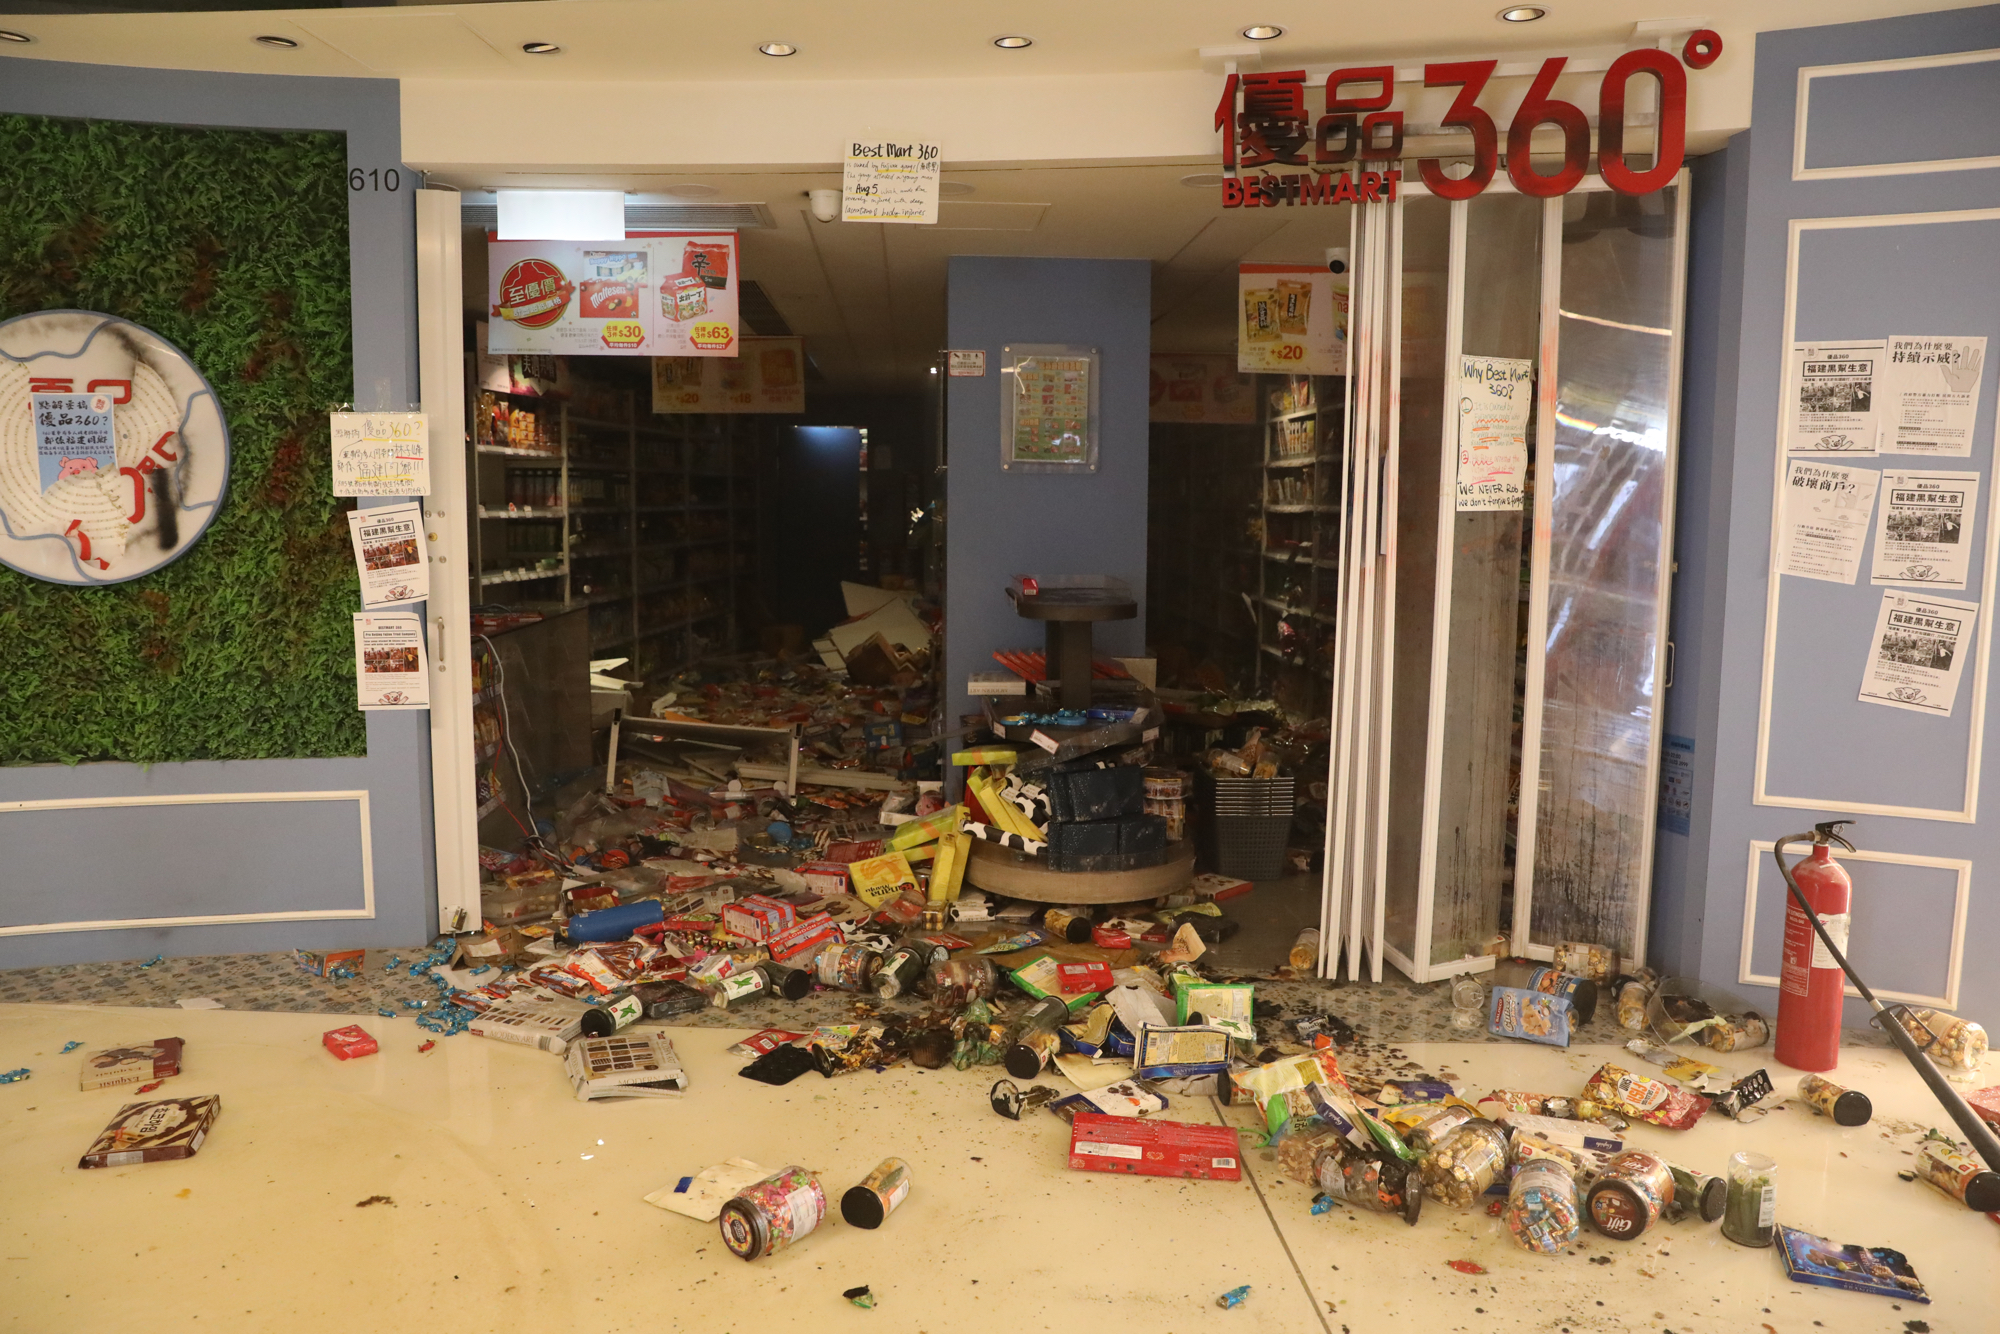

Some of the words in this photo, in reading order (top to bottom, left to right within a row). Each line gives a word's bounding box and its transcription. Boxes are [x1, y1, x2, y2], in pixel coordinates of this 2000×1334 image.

[853, 143, 884, 157] Best
[886, 142, 913, 158] Mart
[917, 143, 938, 160] 360
[871, 162, 879, 172] by
[349, 168, 400, 192] 610
[855, 184, 870, 196] Aug
[872, 183, 879, 195] 5
[1221, 169, 1402, 208] BESTMART
[691, 252, 711, 276] 辛
[509, 277, 556, 305] 至優價
[590, 286, 627, 309] Maltesers
[618, 325, 641, 338] $30
[707, 326, 730, 339] $63
[1894, 342, 1953, 351] 我們為什麼要
[1892, 351, 1961, 364] 持續示威?
[1464, 362, 1483, 384] Why
[1486, 363, 1507, 381] Best
[1510, 367, 1529, 383] Mart
[1807, 363, 1868, 373] 福建黑幫生意
[1489, 383, 1514, 400] 360?
[39, 411, 109, 427] 優品360?
[1795, 466, 1849, 480] 我們為什麼要
[1478, 483, 1504, 495] NEVER
[1792, 476, 1855, 493] 破壞商戶?
[1895, 492, 1959, 504] 福建黑幫生意
[363, 523, 411, 537] 福建黑幫生意
[1893, 613, 1956, 632] 福建黑幫生意
[788, 924, 817, 939] LONDON
[490, 1031, 520, 1041] MODERN
[521, 1036, 534, 1044] ART
[1626, 1081, 1649, 1104] FISH
[1606, 1217, 1633, 1232] Gift
